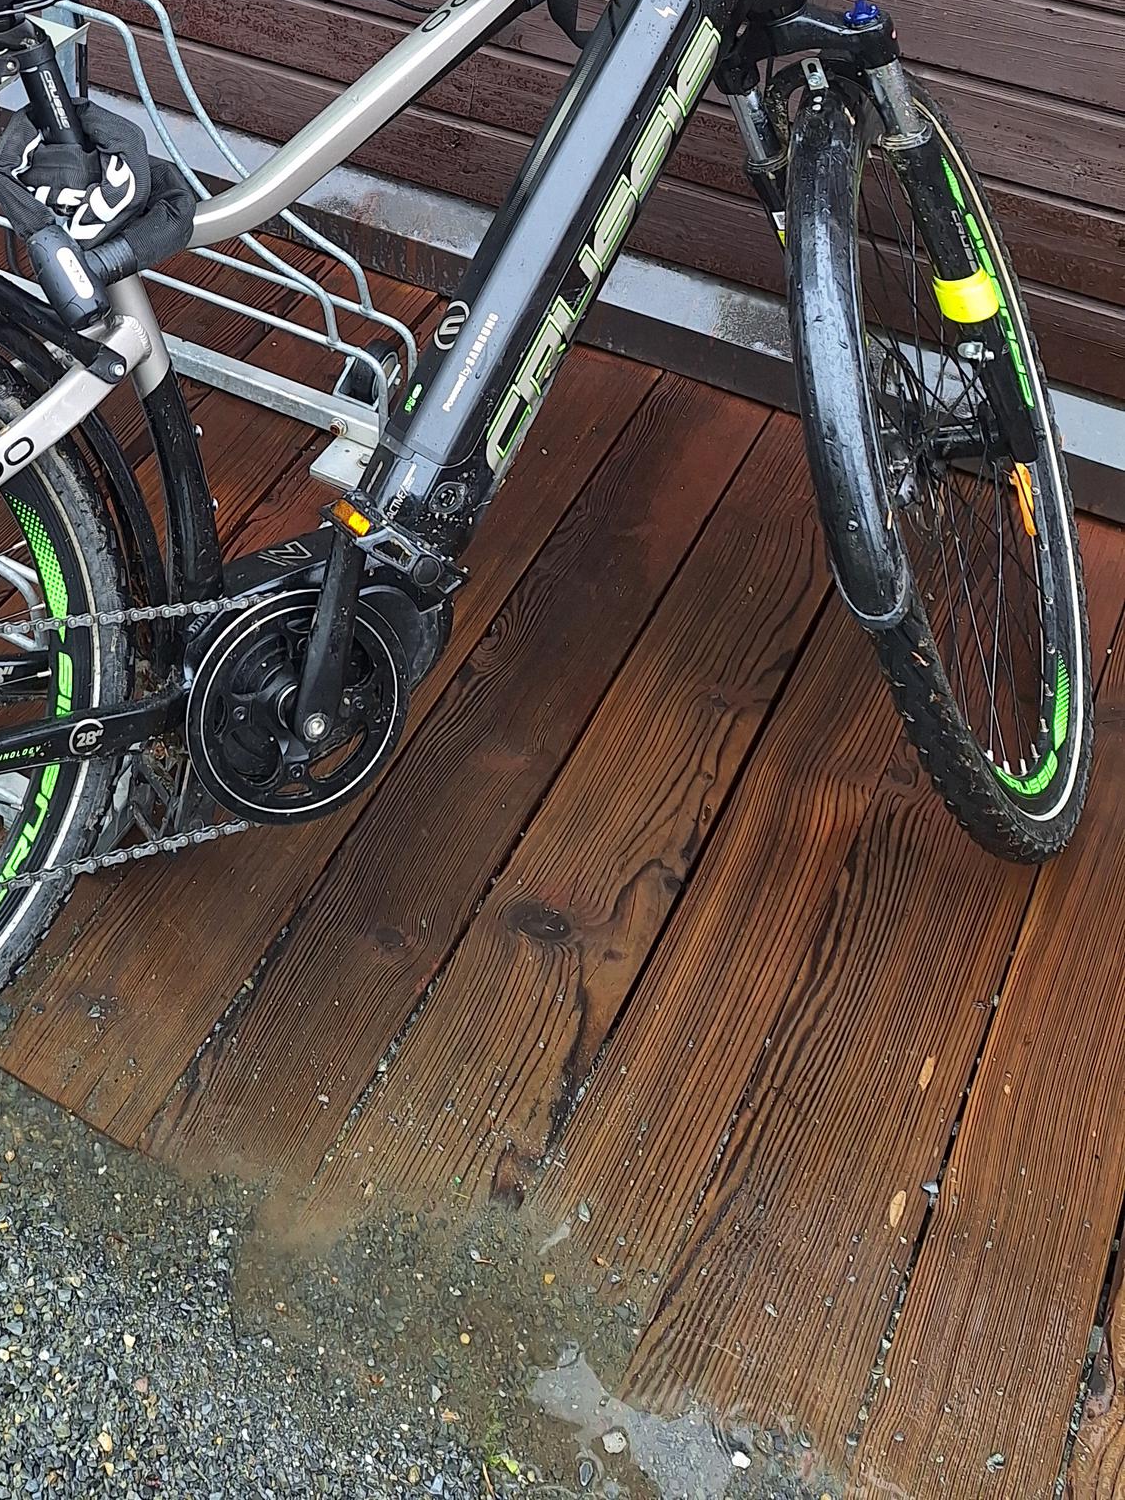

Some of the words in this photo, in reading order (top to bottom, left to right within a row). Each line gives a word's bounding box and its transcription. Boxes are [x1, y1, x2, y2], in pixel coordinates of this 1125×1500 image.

[43, 70, 71, 129] CRUSSIS
[485, 16, 721, 475] CRUSSIS
[465, 312, 499, 367] SAMSUNG
[995, 750, 1059, 795] CRUSSIS
